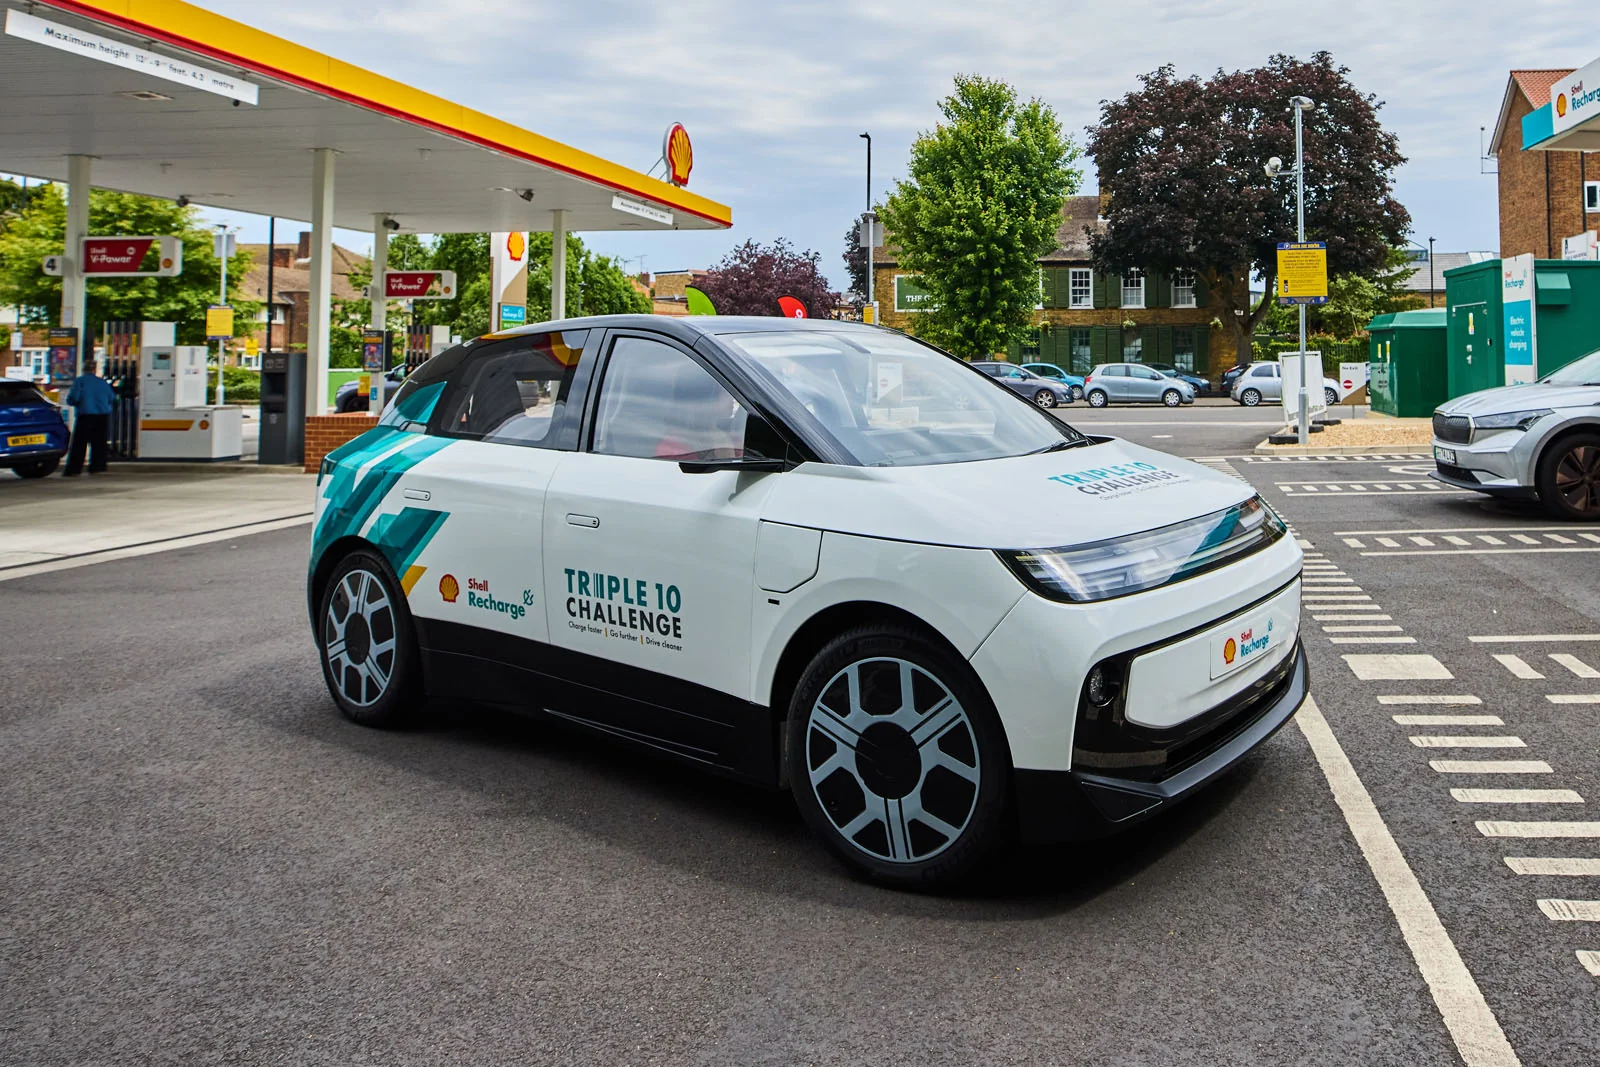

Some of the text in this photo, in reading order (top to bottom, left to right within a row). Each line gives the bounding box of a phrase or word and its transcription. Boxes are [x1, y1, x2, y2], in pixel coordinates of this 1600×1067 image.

[44, 26, 96, 49] Maximum
[98, 42, 129, 59] height
[1571, 80, 1583, 96] Shell
[46, 258, 56, 271] 4
[90, 254, 132, 264] V-Power
[362, 287, 369, 297] 2
[390, 282, 421, 291] V-Power
[1046, 464, 1135, 487] TRIPLE
[1077, 470, 1180, 495] CHALLENGE
[468, 577, 489, 592] Shell
[564, 567, 682, 614] TRIPLE 10
[468, 591, 526, 620] Recharge
[566, 597, 682, 639] CHALLENGE
[568, 620, 683, 652] Charge faster Go further Drive cleaner
[1240, 628, 1252, 643] Shell
[1240, 634, 1270, 657] Recharge
